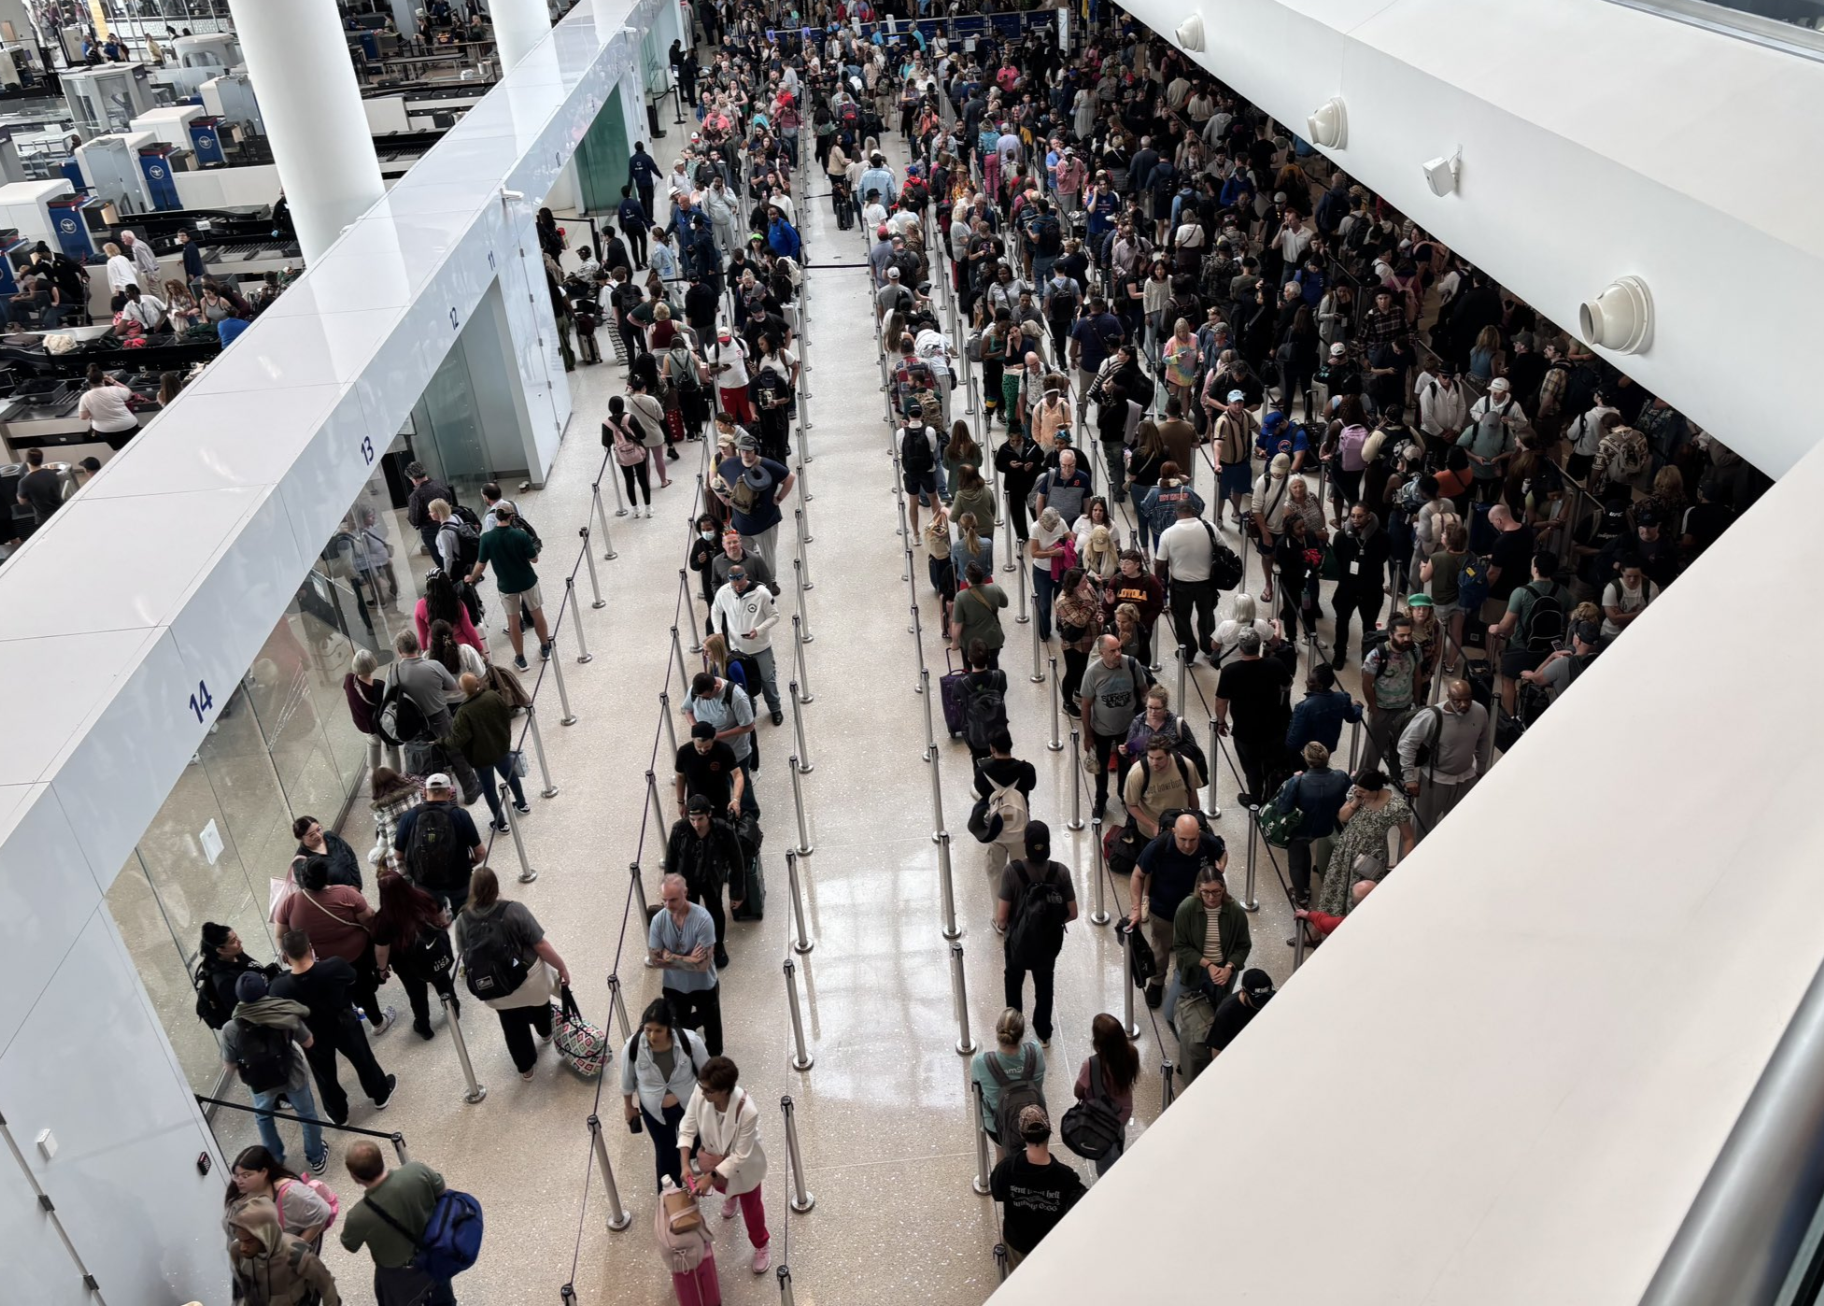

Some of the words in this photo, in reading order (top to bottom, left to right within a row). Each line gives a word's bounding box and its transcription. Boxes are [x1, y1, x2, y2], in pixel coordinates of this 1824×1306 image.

[488, 250, 496, 271] 11
[449, 306, 460, 331] 12
[360, 435, 375, 467] 13
[1117, 588, 1148, 601] LOYOLA
[188, 679, 214, 725] 14
